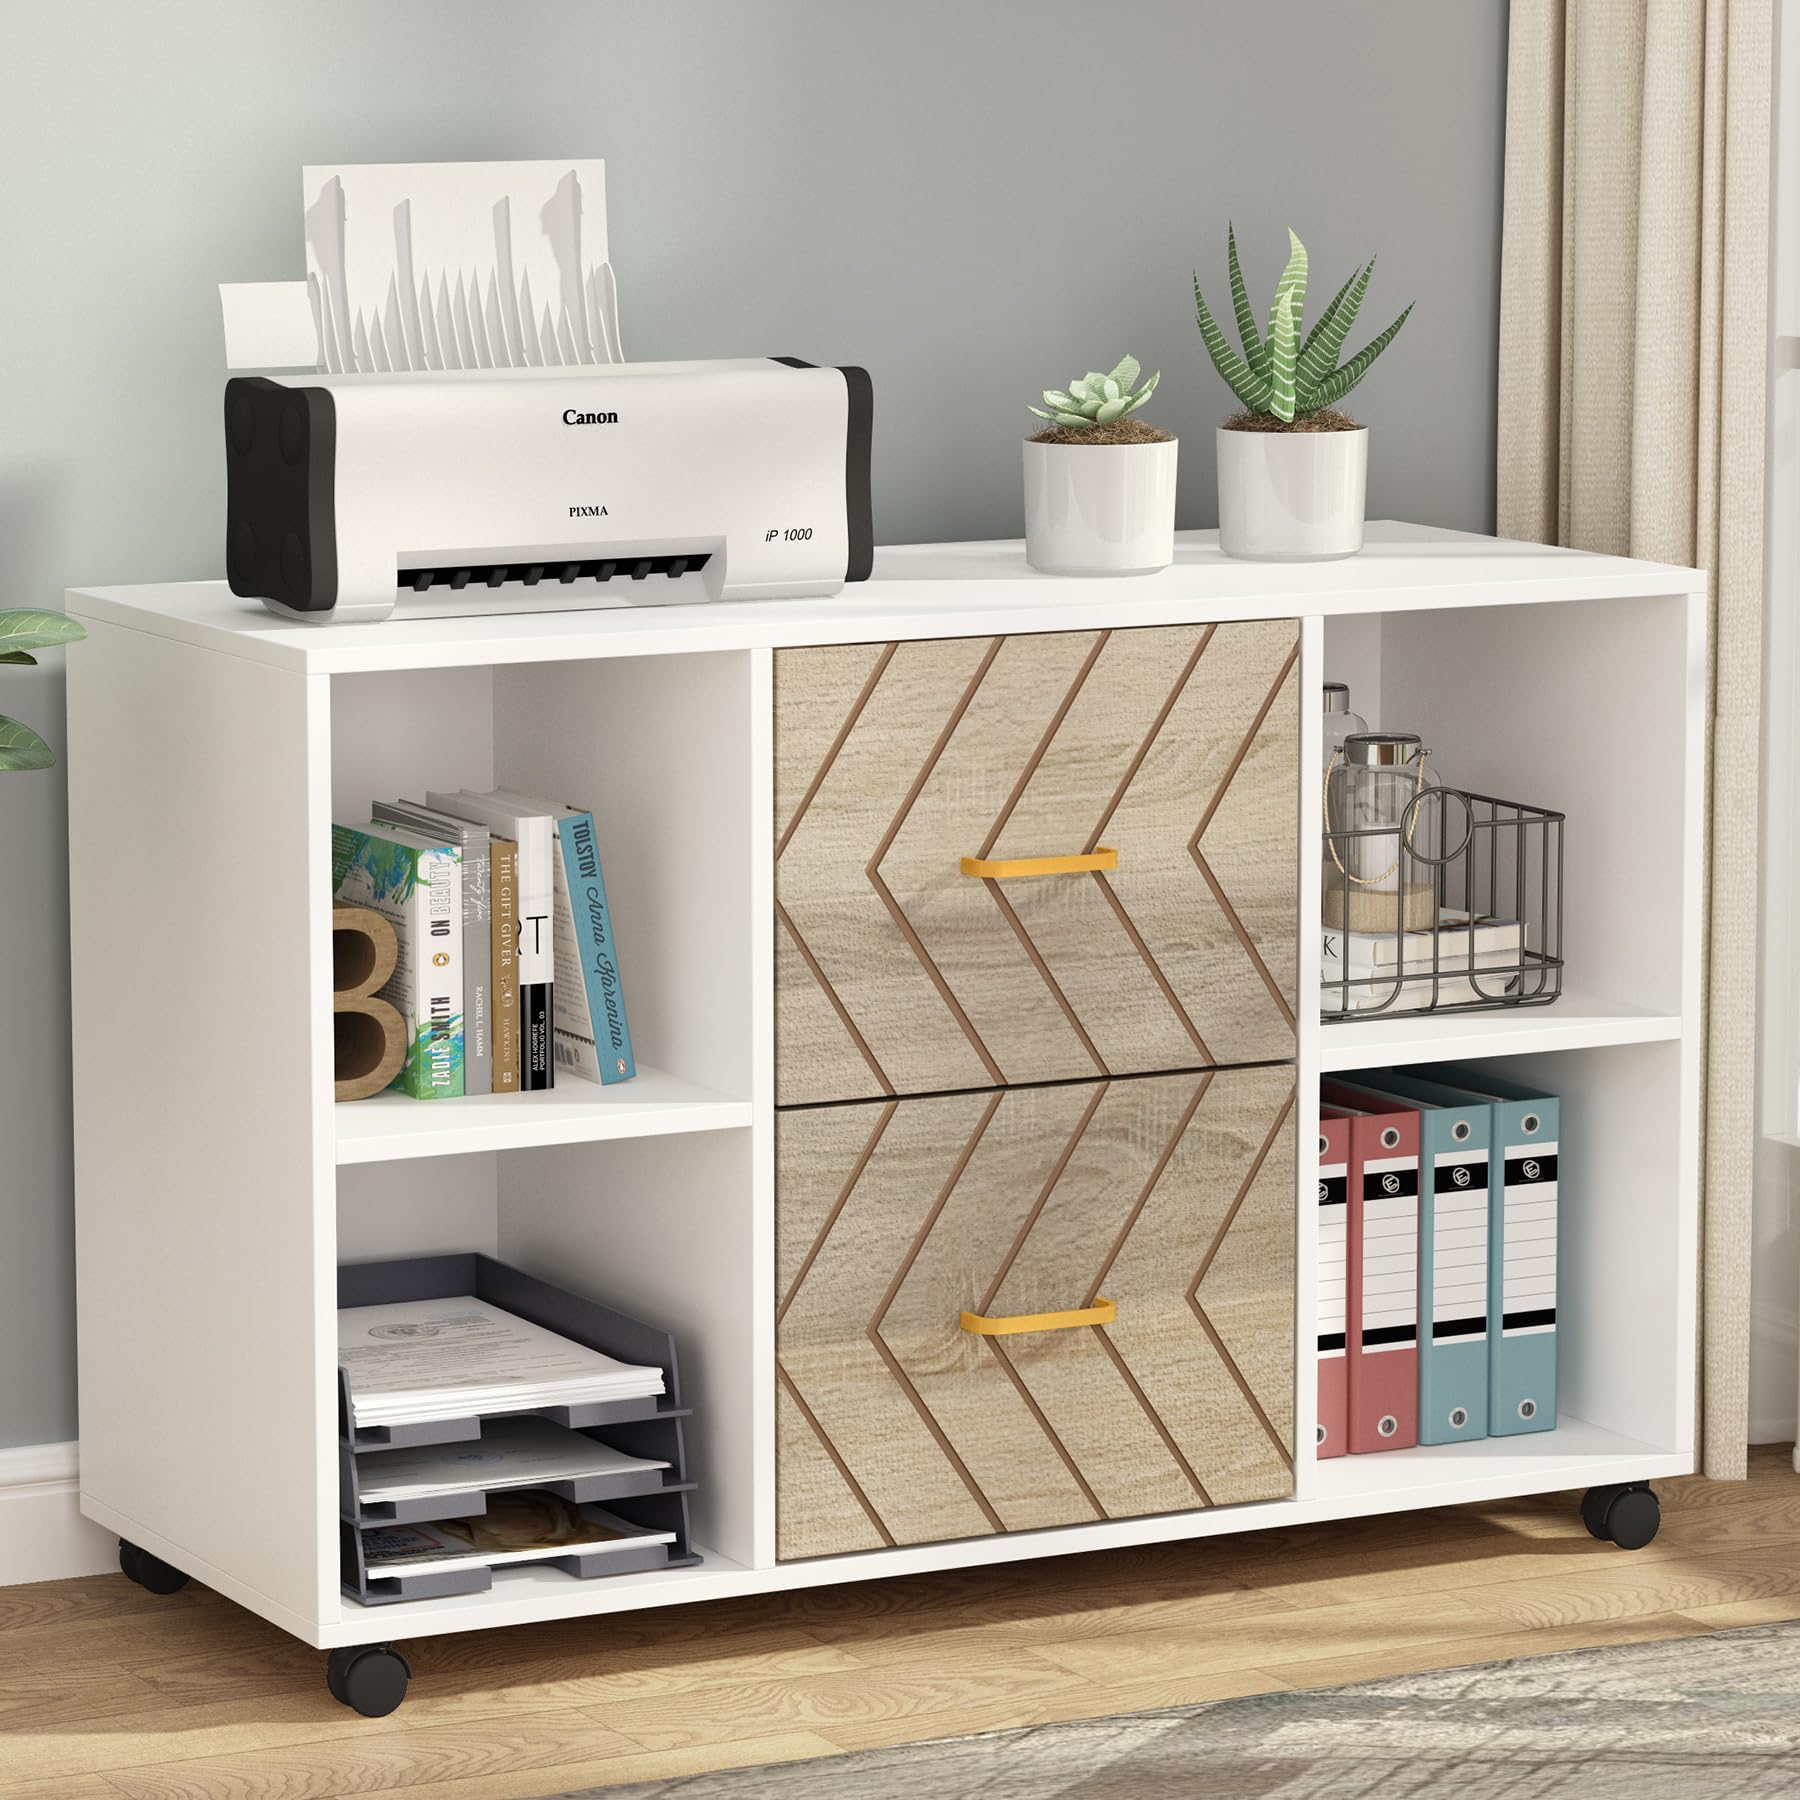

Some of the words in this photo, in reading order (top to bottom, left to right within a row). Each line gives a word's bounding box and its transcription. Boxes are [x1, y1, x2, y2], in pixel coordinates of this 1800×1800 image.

[562, 409, 619, 425] Canon
[569, 505, 609, 517] PIXMA
[765, 529, 779, 542] iP
[784, 527, 813, 541] 1000
[572, 820, 597, 878] TOLSTOY
[500, 854, 511, 883] THE
[430, 861, 451, 916] BEAUTY
[501, 887, 512, 920] GIFT
[430, 919, 451, 937] ON
[586, 886, 605, 947] Anna
[501, 923, 512, 967] GIVER
[475, 986, 483, 1020] RACHEL
[593, 952, 623, 1050] Karenina
[430, 996, 451, 1041] SMITH
[476, 1029, 484, 1057] HAMM
[503, 1018, 511, 1063] HAWKINS
[531, 1023, 539, 1054] HOGREFE
[431, 1046, 451, 1087] ZADIE
